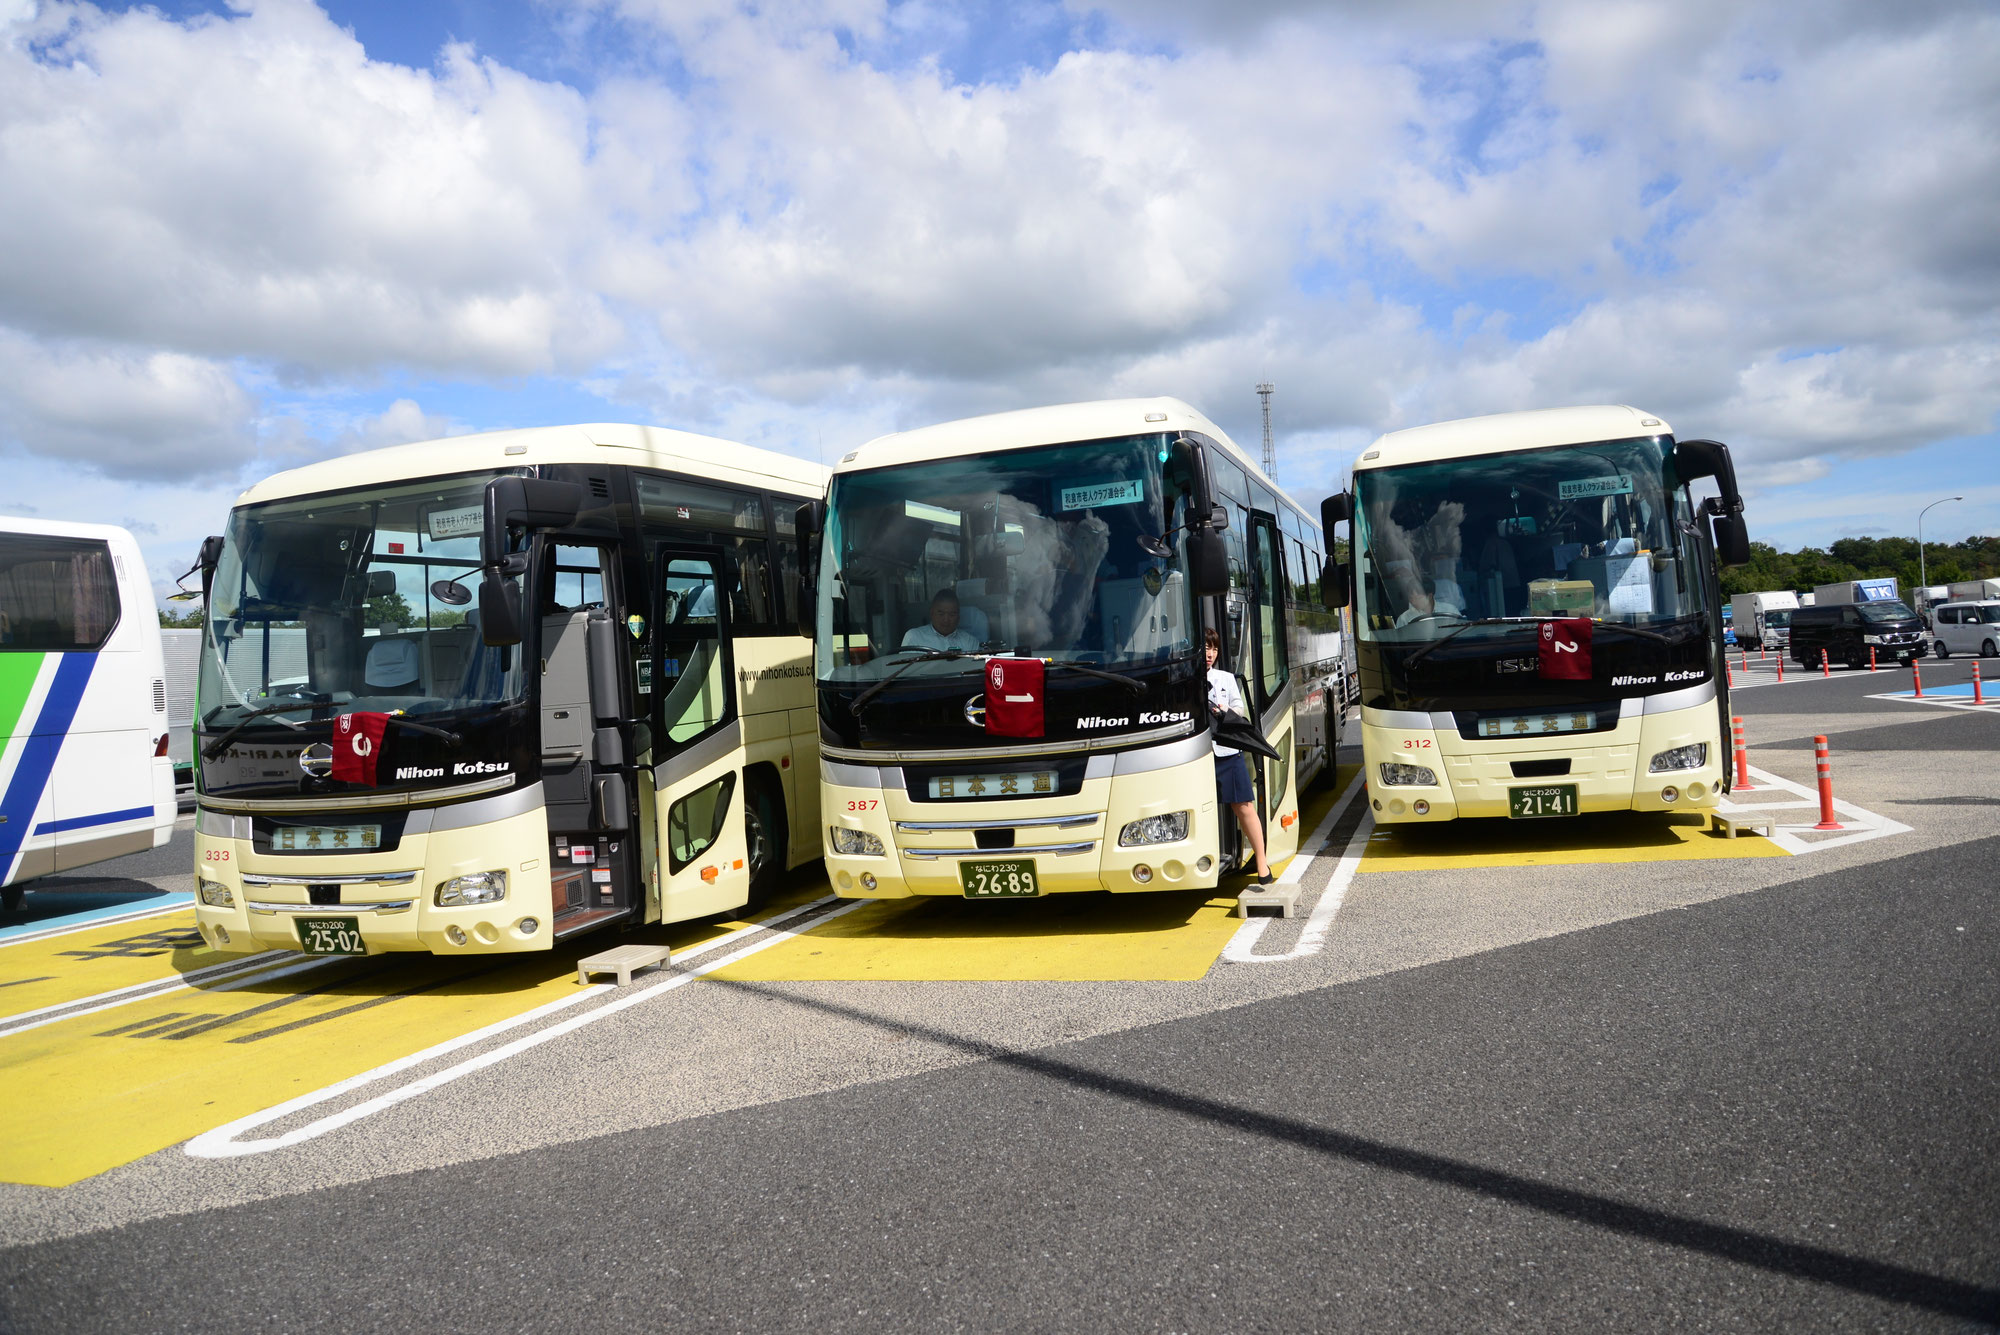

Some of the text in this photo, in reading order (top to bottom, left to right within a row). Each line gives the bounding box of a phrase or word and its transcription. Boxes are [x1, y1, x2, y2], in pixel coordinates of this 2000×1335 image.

[1866, 586, 1892, 599] TK
[1555, 641, 1579, 653] 2
[1496, 657, 1540, 674] ISU
[1611, 670, 1705, 686] Nihon Kotsu
[1005, 692, 1034, 702] 1
[1076, 710, 1191, 729] Nihon Kotsu
[1486, 713, 1589, 735] 日本交通
[1403, 739, 1432, 749] 312
[395, 761, 510, 780] Nihon Kotsu
[938, 772, 1051, 796] 日本交通
[847, 800, 878, 811] 387
[1521, 794, 1571, 815] 21-41
[281, 826, 377, 849] 日本交通
[205, 850, 230, 861] 333
[975, 872, 1035, 895] 26-89
[310, 930, 364, 952] 25-02
